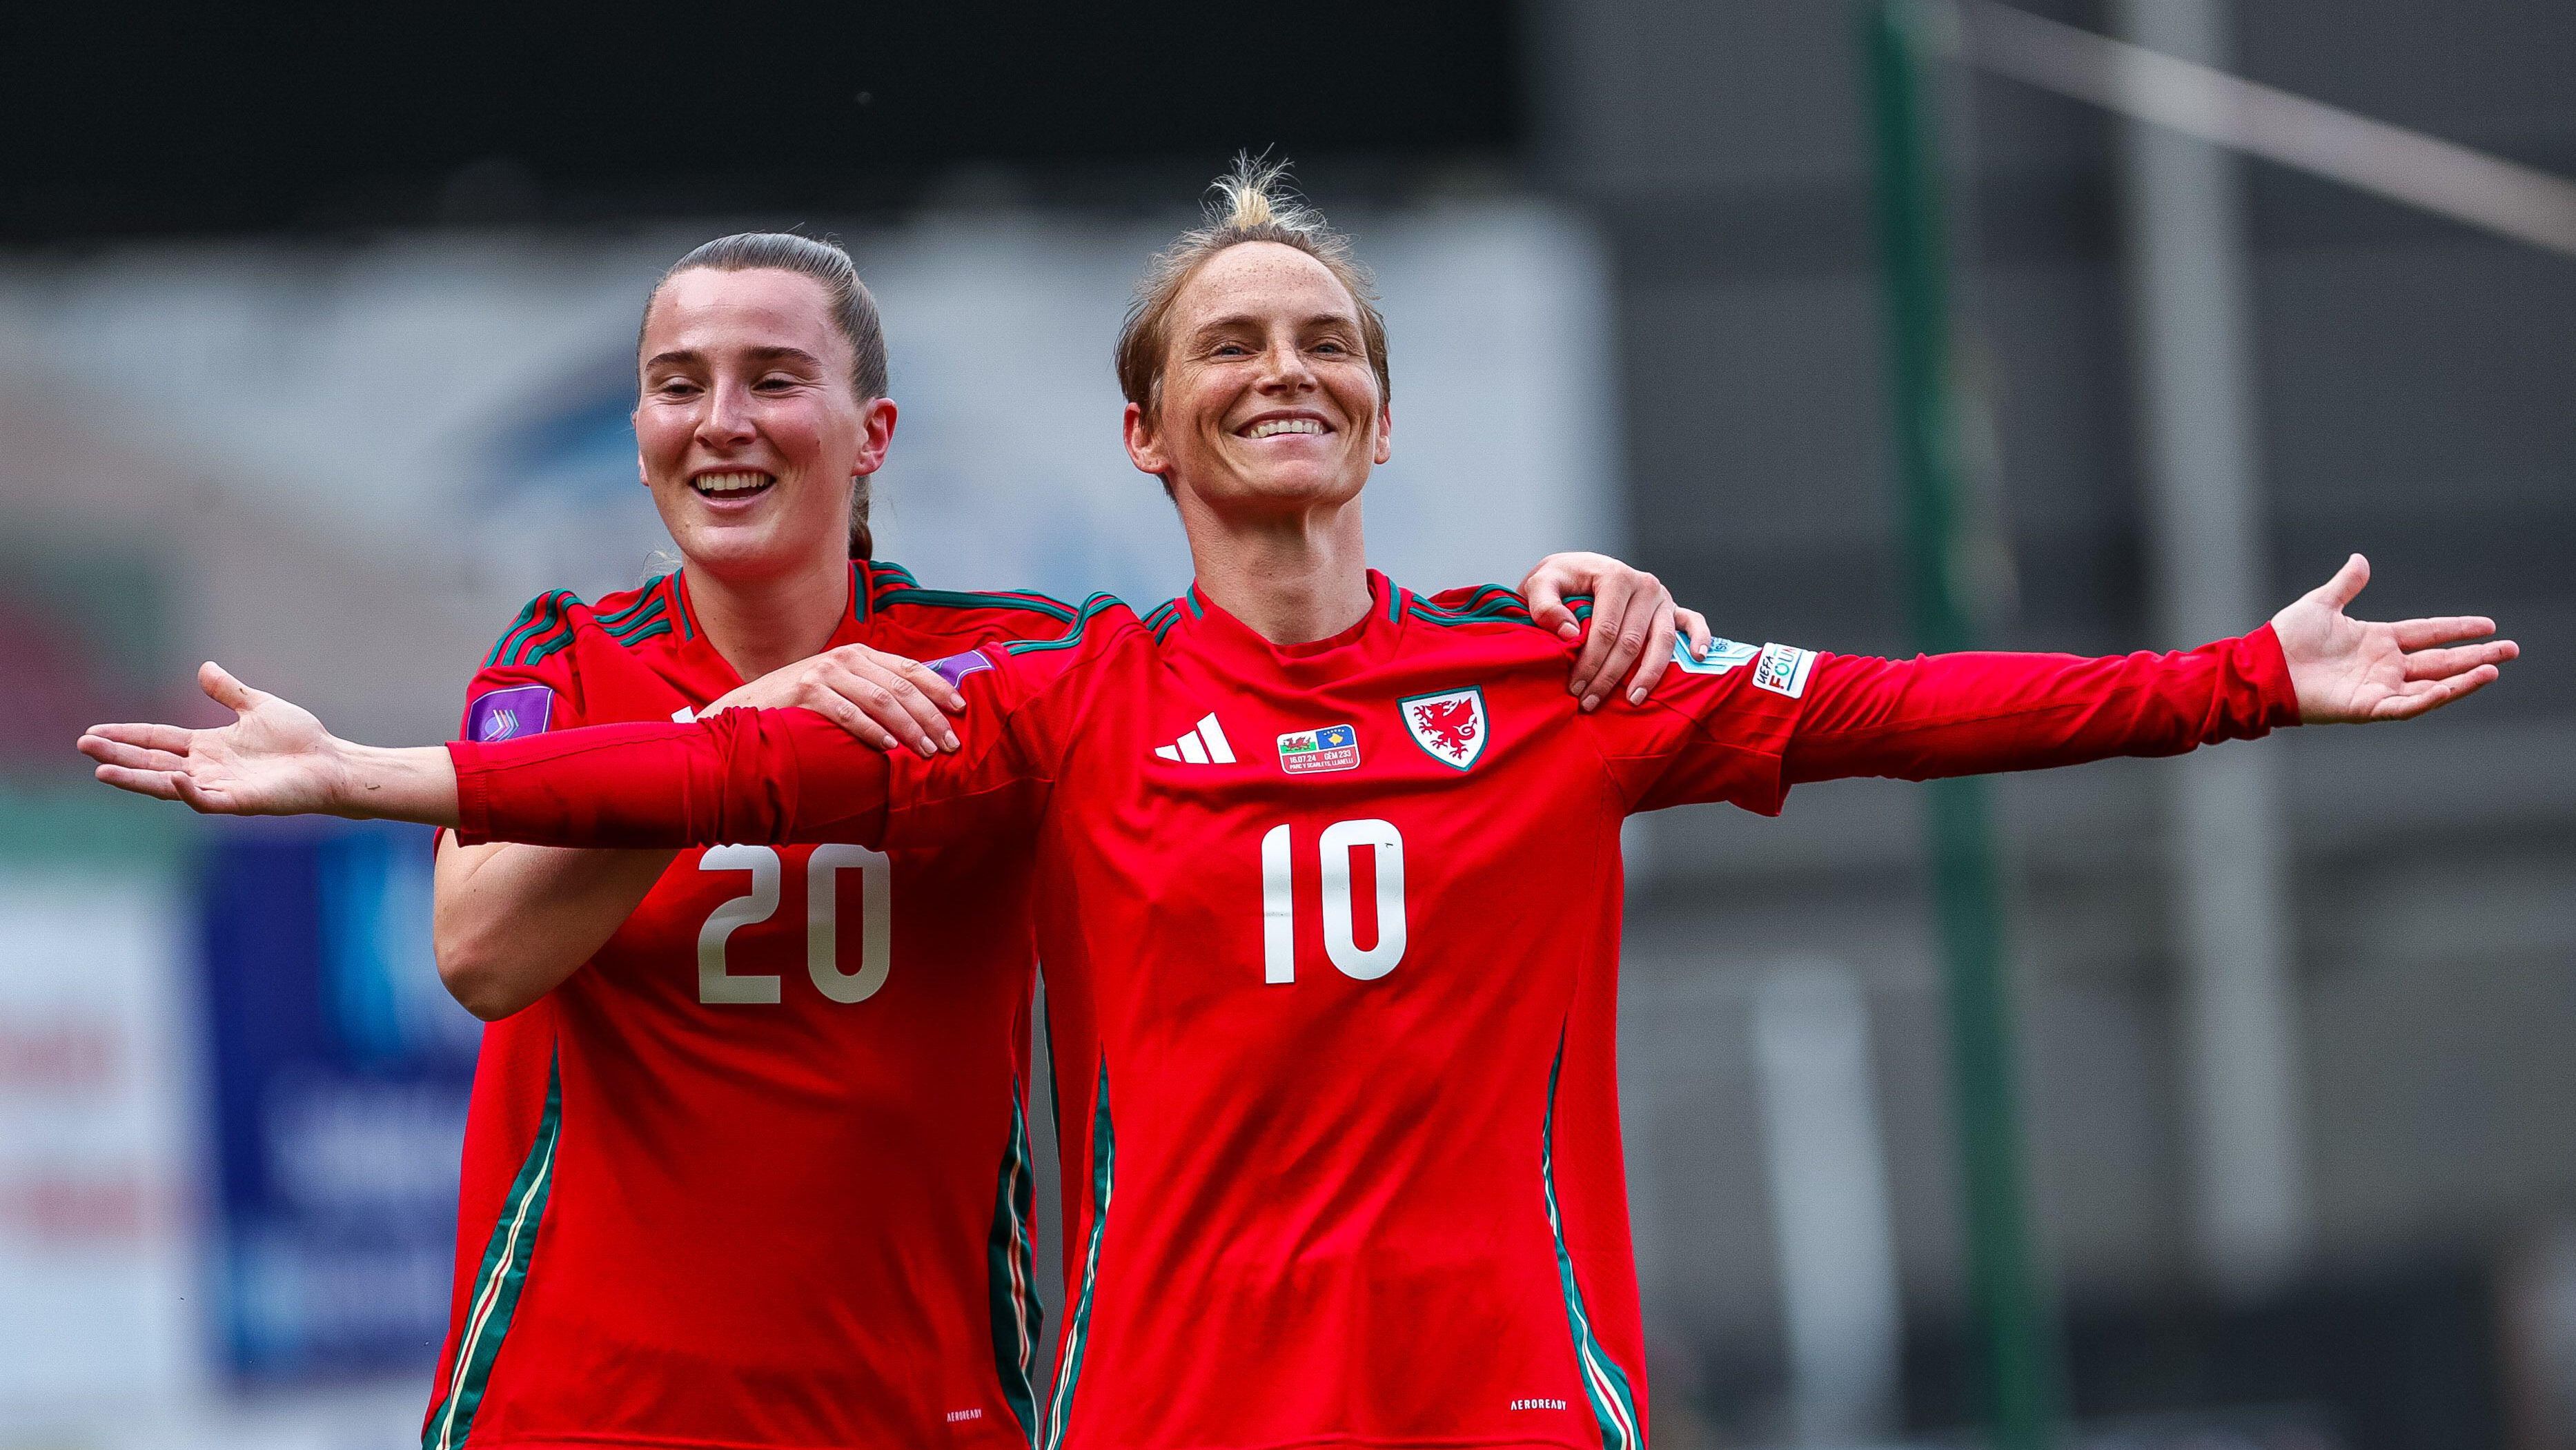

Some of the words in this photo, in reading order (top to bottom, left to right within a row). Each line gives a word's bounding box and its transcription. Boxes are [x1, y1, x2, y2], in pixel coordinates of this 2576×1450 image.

[1757, 656, 1774, 685] UEFA
[1289, 754, 1317, 764] 16.07.24
[1339, 750, 1352, 758] 233
[1261, 819, 1407, 983] 10
[698, 843, 890, 1003] 20
[947, 1408, 982, 1422] AEROREADY
[1511, 1398, 1566, 1411] AEROREADY
